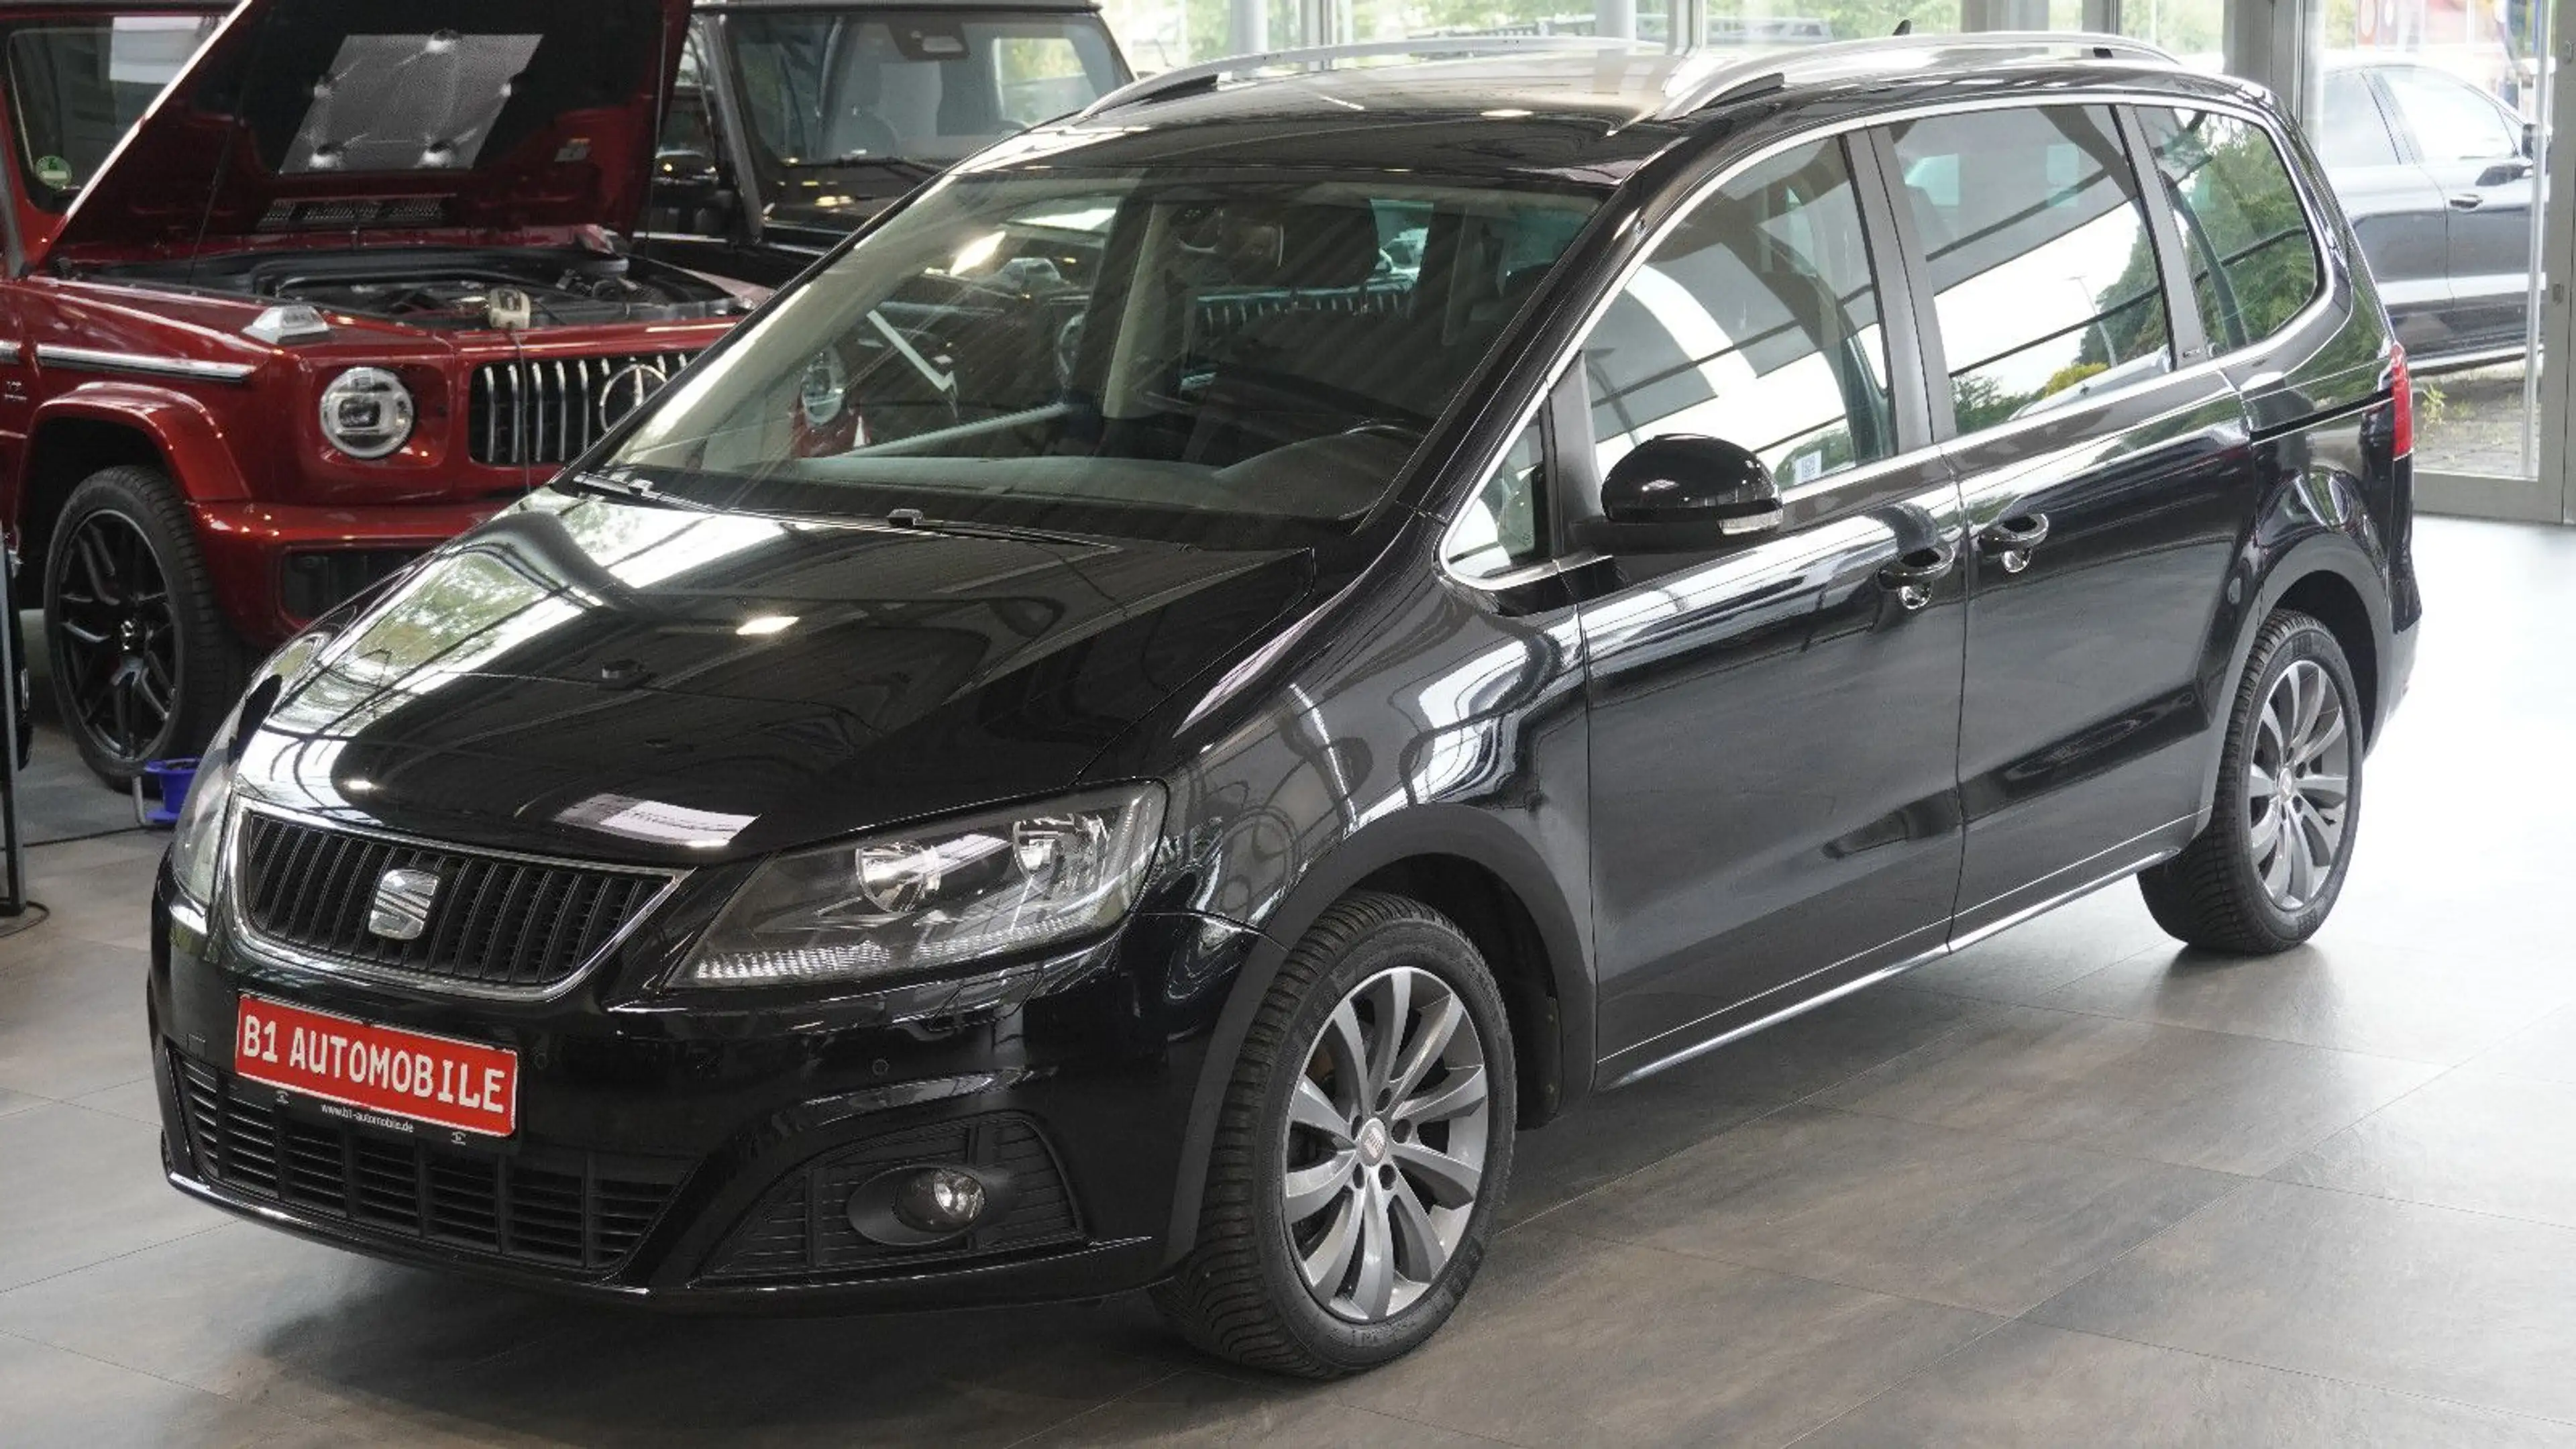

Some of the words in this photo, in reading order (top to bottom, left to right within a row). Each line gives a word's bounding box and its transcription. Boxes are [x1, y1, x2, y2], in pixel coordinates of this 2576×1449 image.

[243, 1014, 278, 1063] B1
[289, 1027, 505, 1114] AUTOMOBILE
[321, 1104, 413, 1133] www.b1-automobile.de
